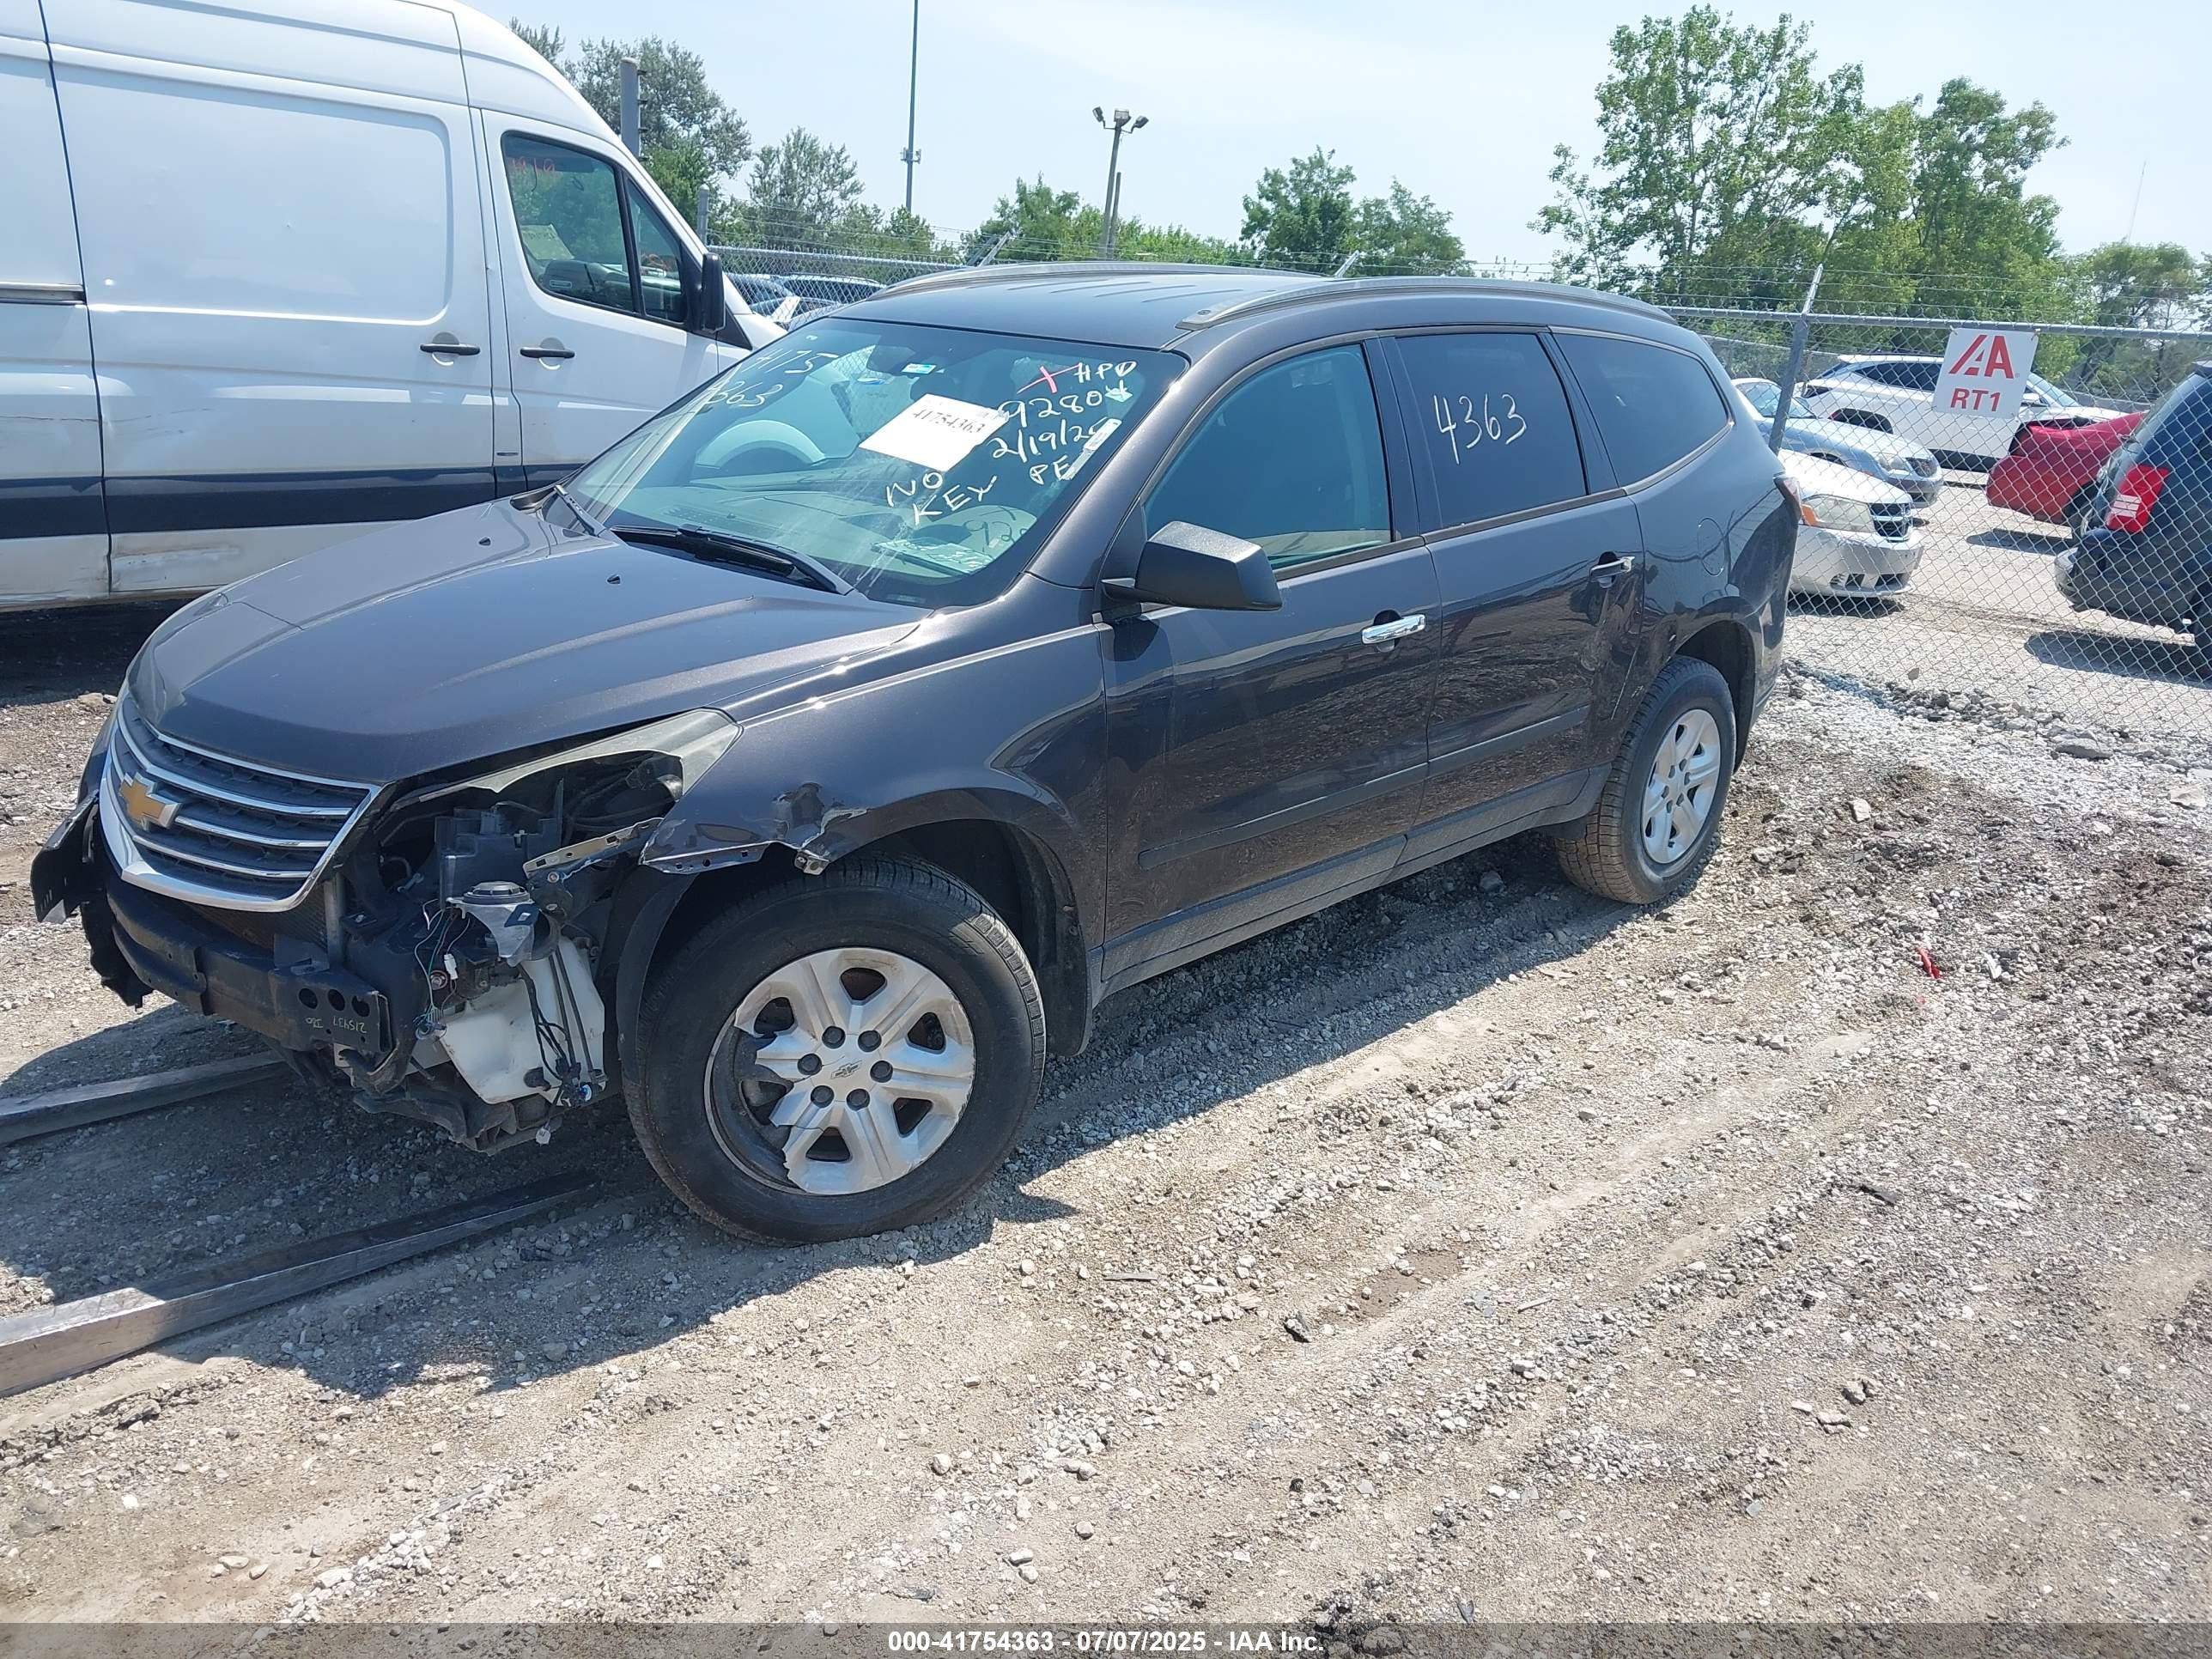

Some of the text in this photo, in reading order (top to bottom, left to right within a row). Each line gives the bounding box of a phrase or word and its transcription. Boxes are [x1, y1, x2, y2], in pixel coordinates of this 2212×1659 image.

[1950, 387, 2001, 412] RT1
[913, 409, 986, 434] 41754363
[1433, 393, 1527, 465] 4363
[886, 472, 943, 507] NO
[913, 476, 997, 526] KEY
